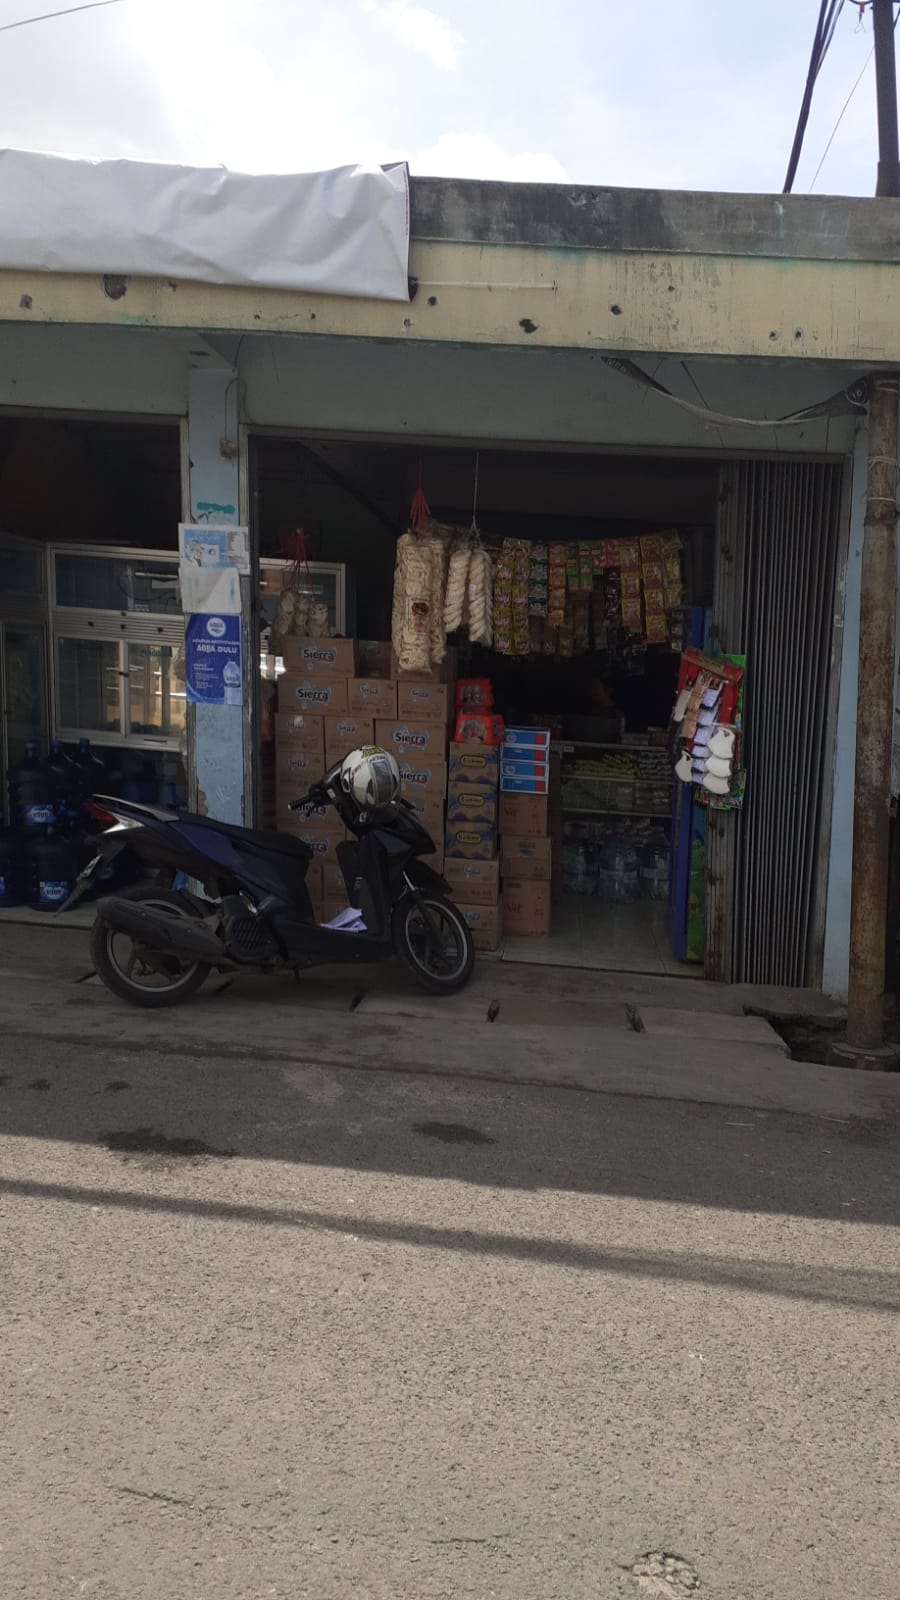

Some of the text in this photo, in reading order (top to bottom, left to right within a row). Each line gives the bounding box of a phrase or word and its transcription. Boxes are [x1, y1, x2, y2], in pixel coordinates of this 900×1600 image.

[217, 646, 238, 654] DULU
[303, 649, 335, 662] Sierra
[298, 689, 329, 702] Sierra
[395, 732, 426, 746] Sierra
